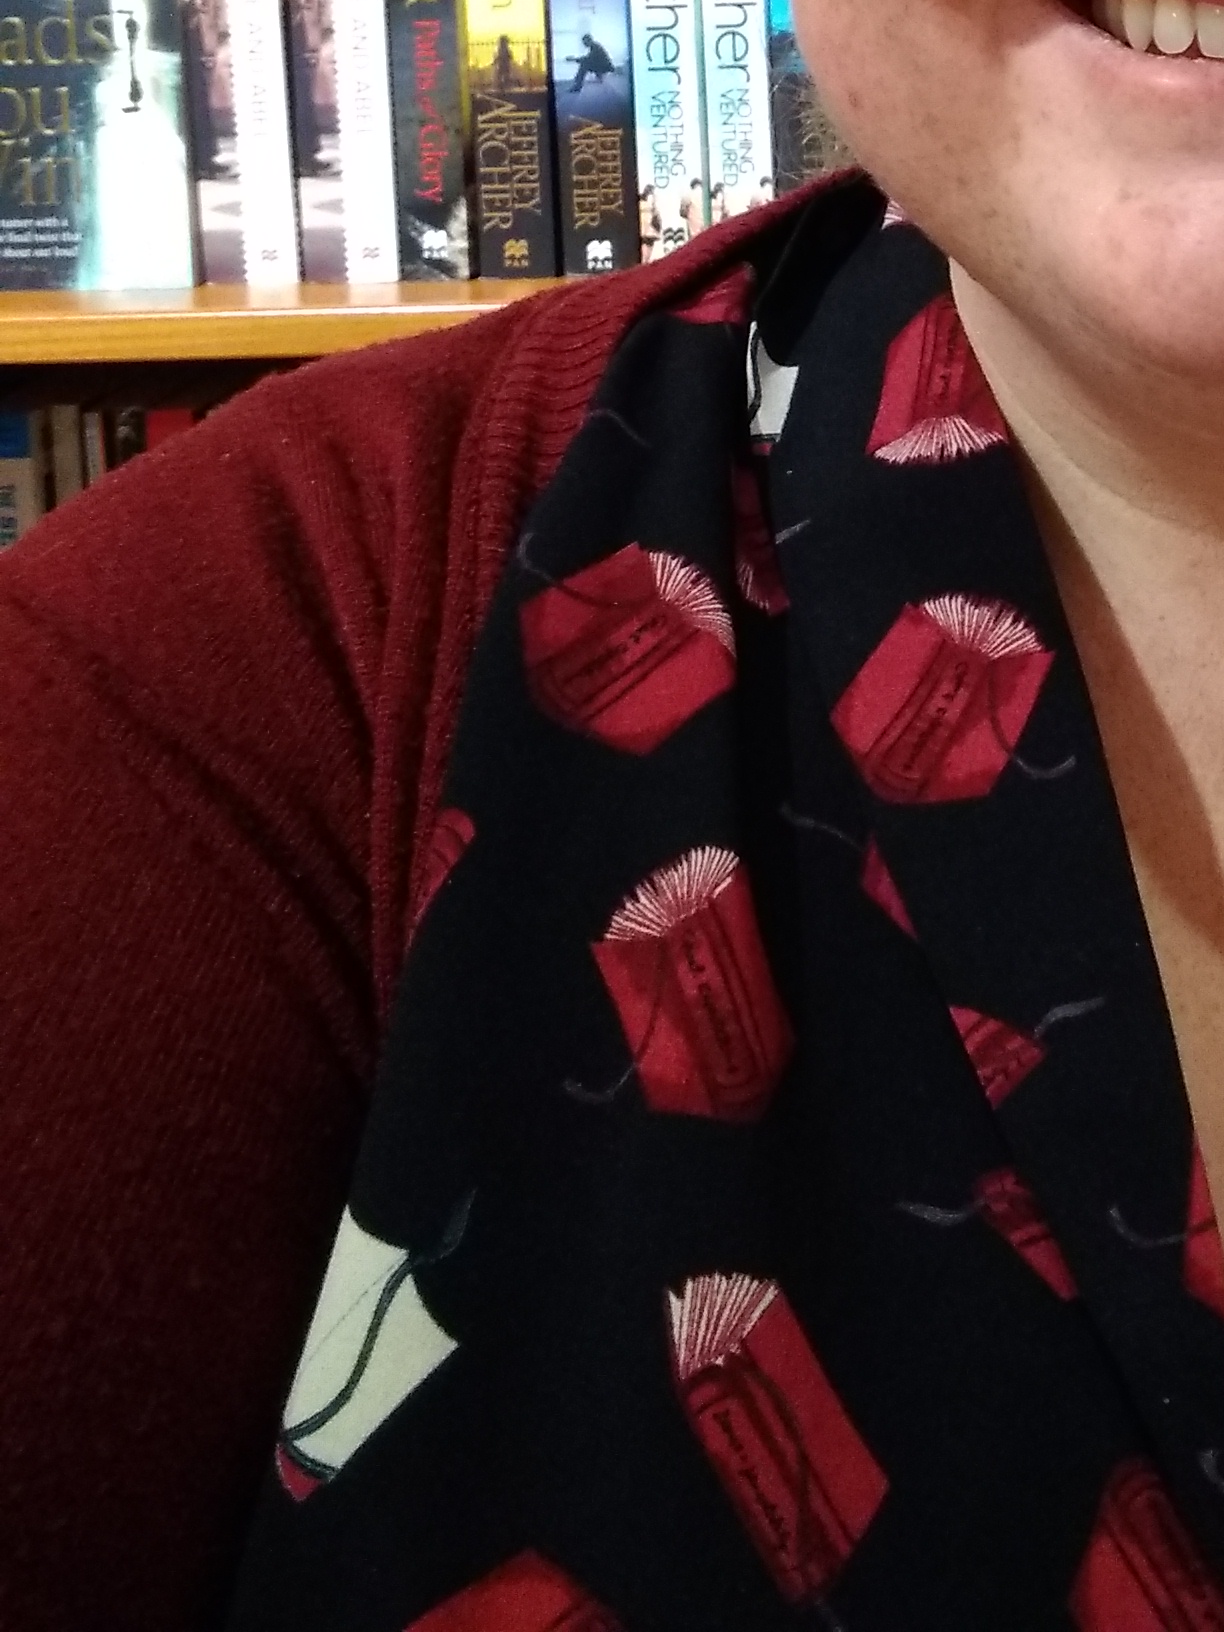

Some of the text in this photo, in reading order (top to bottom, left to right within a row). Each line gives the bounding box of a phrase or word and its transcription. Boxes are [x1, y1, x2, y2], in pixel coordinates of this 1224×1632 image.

[246, 21, 264, 72] AND
[349, 17, 369, 70] AND
[413, 19, 441, 92] Paths
[416, 119, 446, 204] Glory
[473, 90, 511, 232] ARCHER
[503, 107, 542, 216] JEFFREY
[568, 115, 605, 230] ARCHER
[602, 127, 623, 216] JEFFREY
[646, 90, 669, 191] VENTURED
[666, 90, 687, 176] NOTHING
[719, 89, 739, 188] VENTURED
[735, 89, 755, 175] NOTHING
